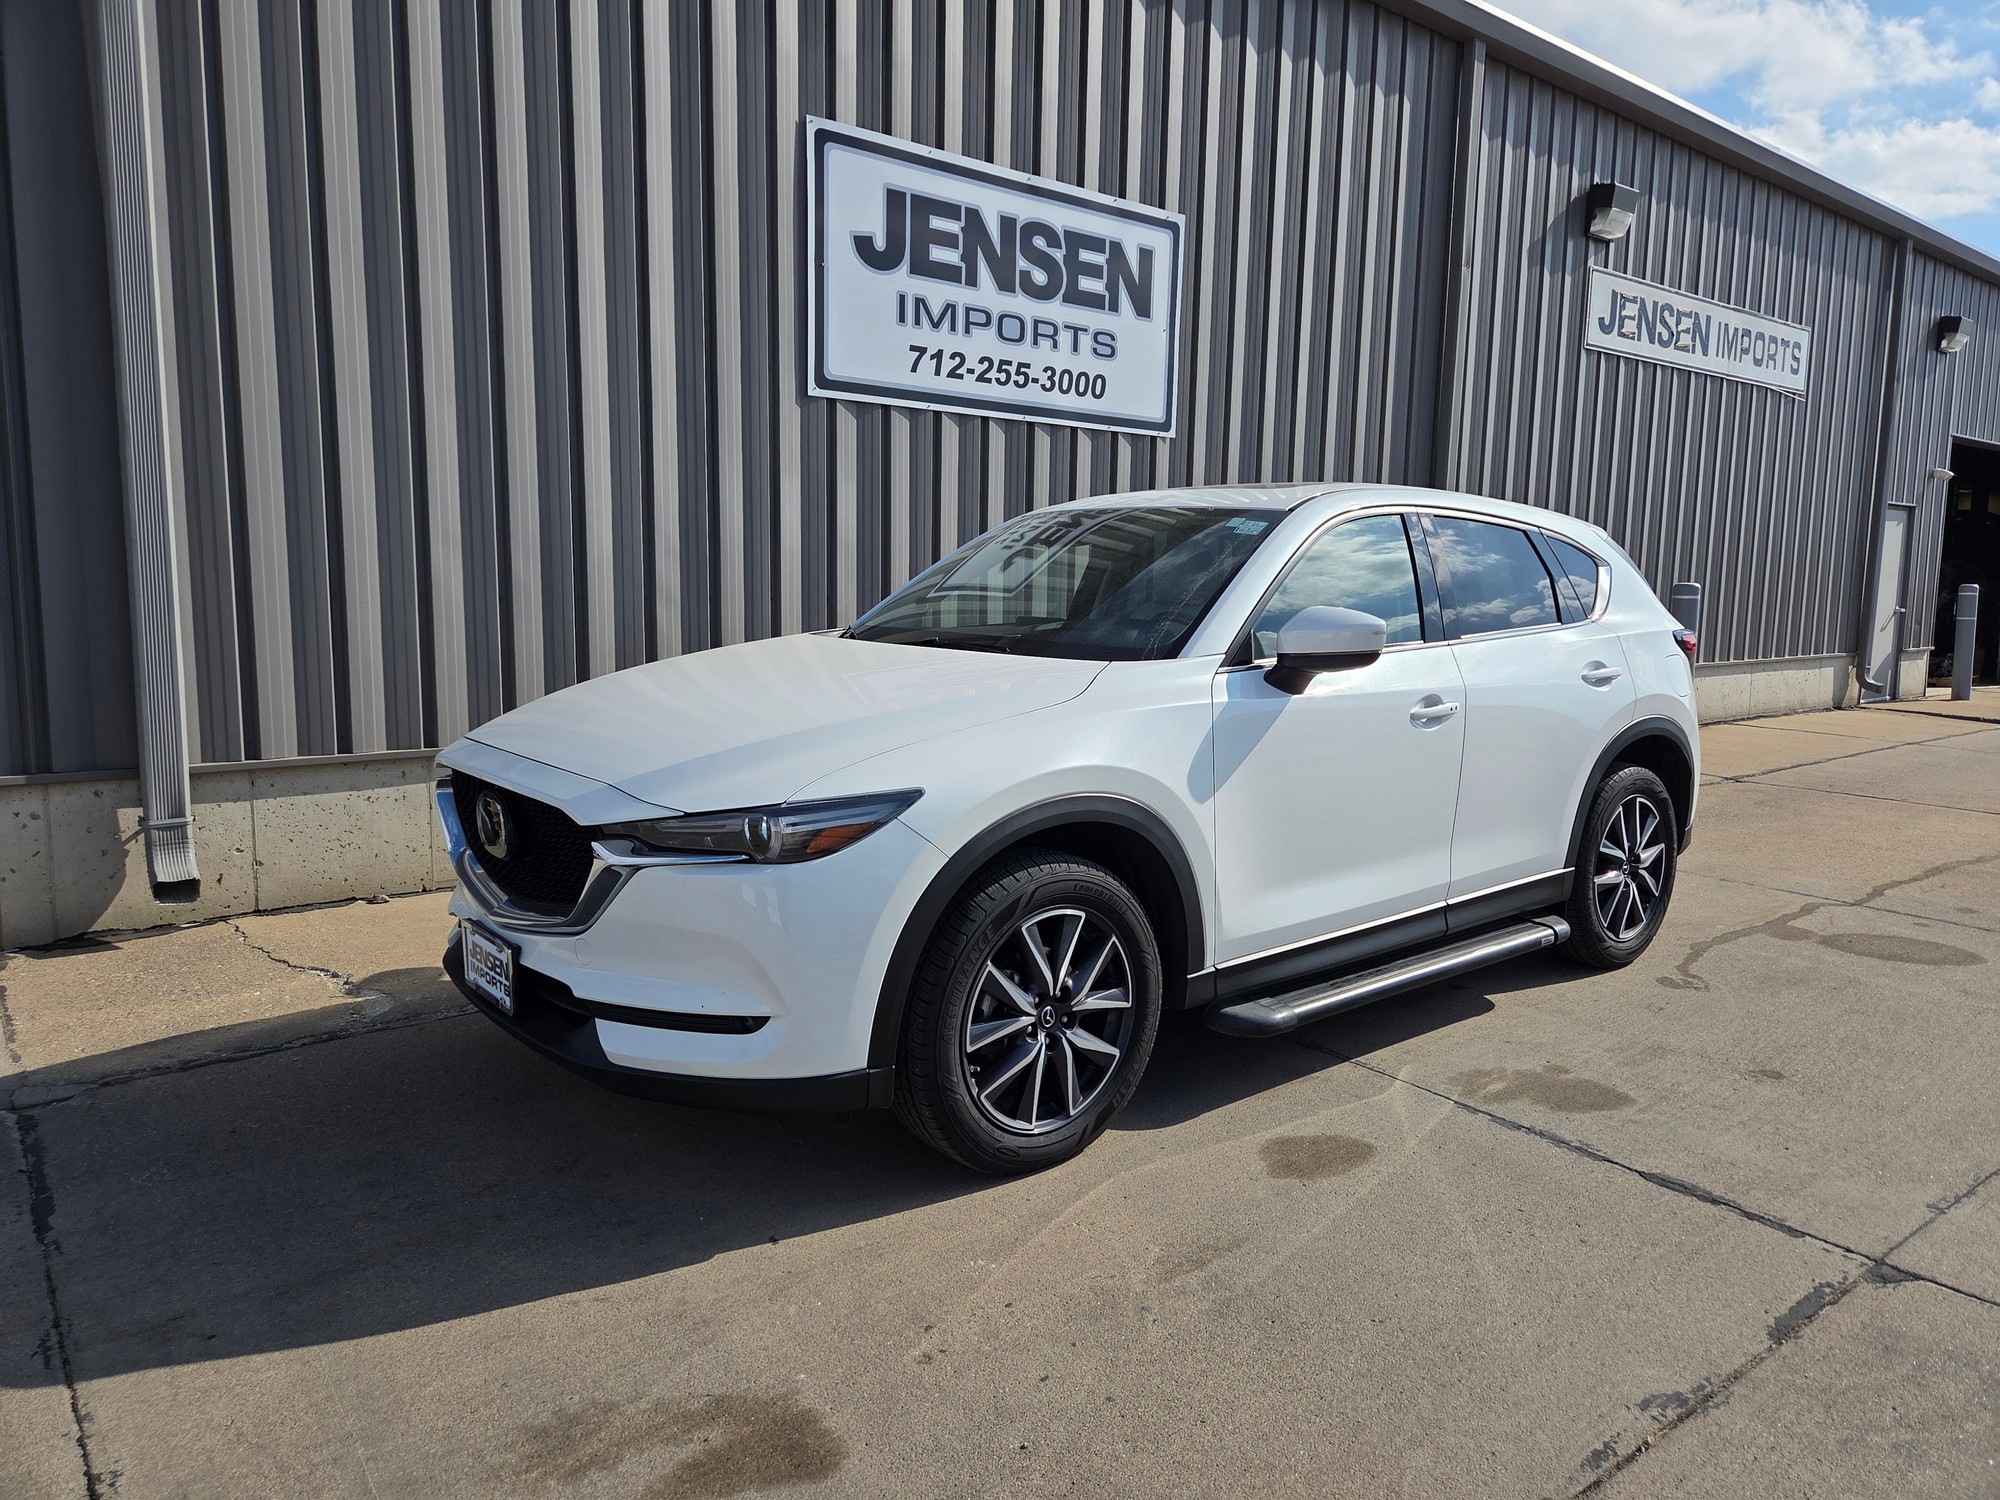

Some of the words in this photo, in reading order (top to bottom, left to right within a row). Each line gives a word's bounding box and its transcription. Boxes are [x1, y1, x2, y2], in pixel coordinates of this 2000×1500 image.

[852, 186, 1155, 321] JENSEN
[897, 292, 1118, 360] IMPORTS
[1597, 288, 1712, 357] JENSEN
[1715, 321, 1802, 376] IMPORTS
[908, 344, 1107, 399] 712-255-3000
[470, 940, 509, 980] JENSEN
[470, 960, 511, 998] IMPORTS
[943, 924, 996, 1045] ASSURANCE
